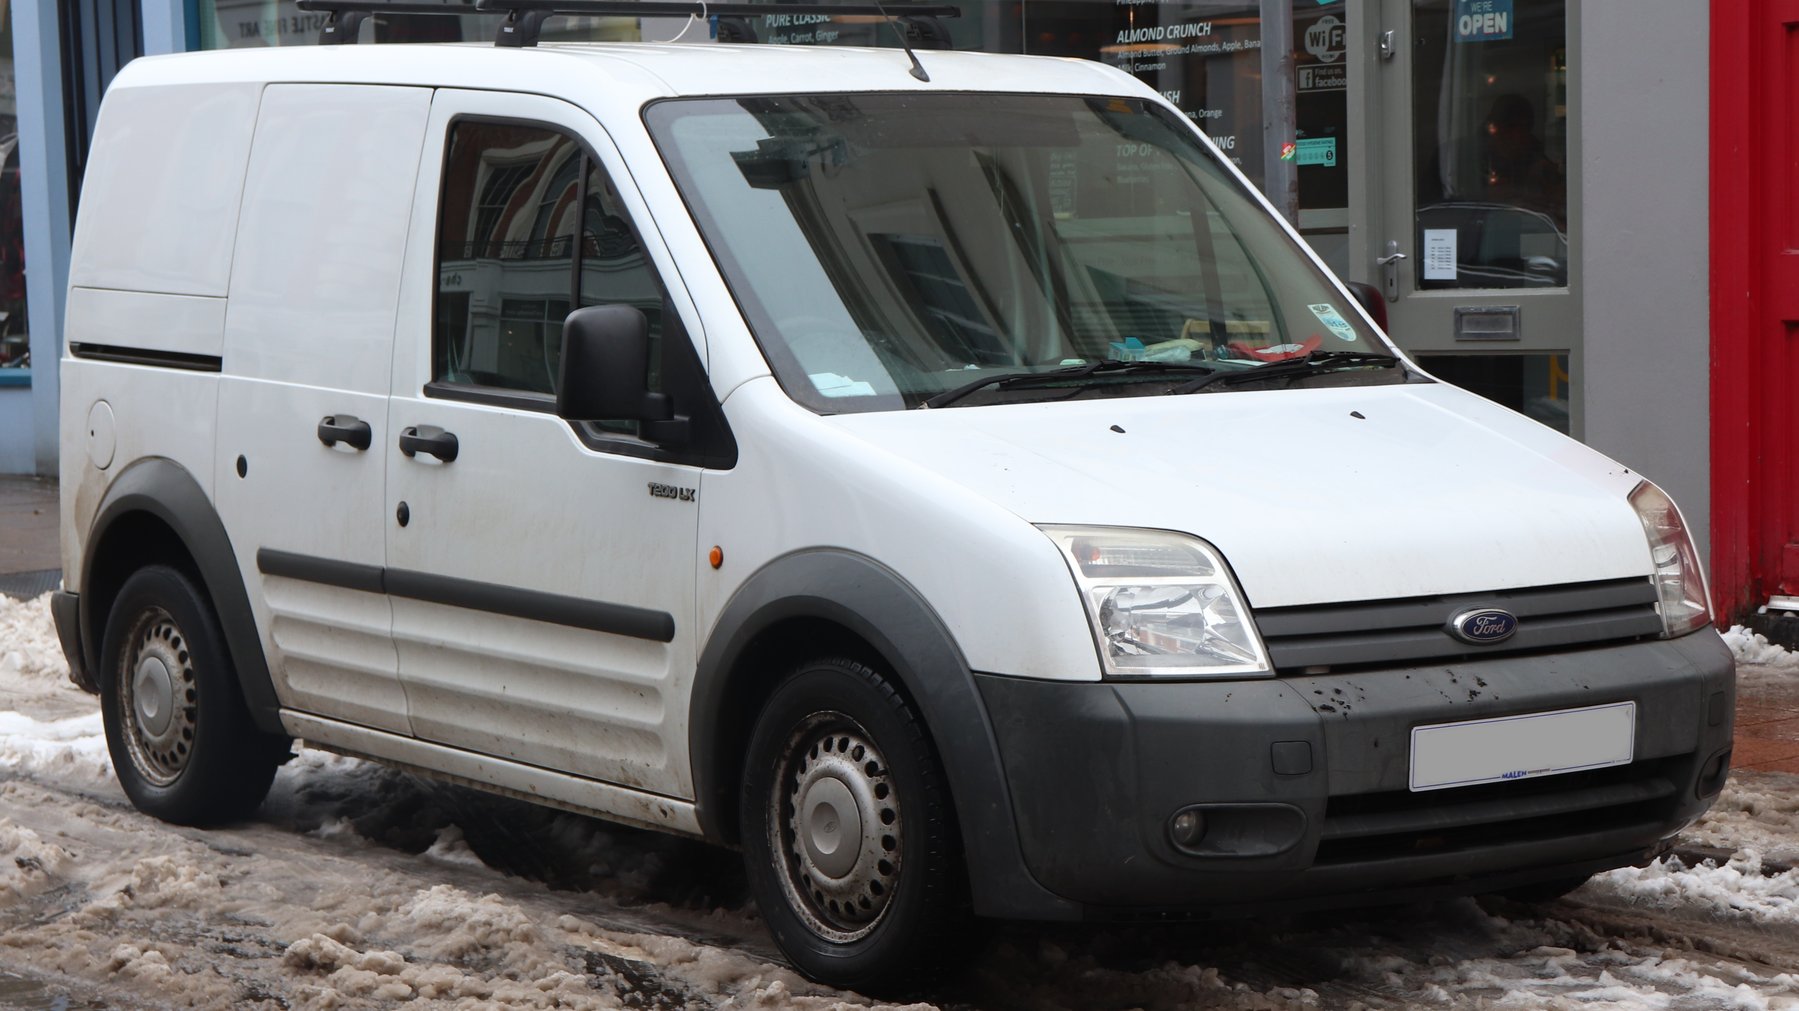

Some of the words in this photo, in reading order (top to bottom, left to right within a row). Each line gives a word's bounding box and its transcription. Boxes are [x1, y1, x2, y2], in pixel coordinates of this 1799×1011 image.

[766, 14, 791, 28] PURE
[1459, 11, 1507, 35] OPEN
[791, 32, 814, 43] Carrot,
[815, 30, 839, 43] Ginger
[1116, 26, 1164, 44] ALMOND
[1166, 22, 1212, 39] CRUNCH
[1166, 44, 1189, 55] Ground
[1191, 42, 1221, 53] Almonds,
[1222, 40, 1243, 52] Apple,
[1134, 62, 1166, 72] Cinnamon
[1198, 108, 1223, 119] Orange
[1117, 144, 1138, 157] TOP
[679, 487, 696, 503] LX
[1473, 616, 1506, 635] Ford
